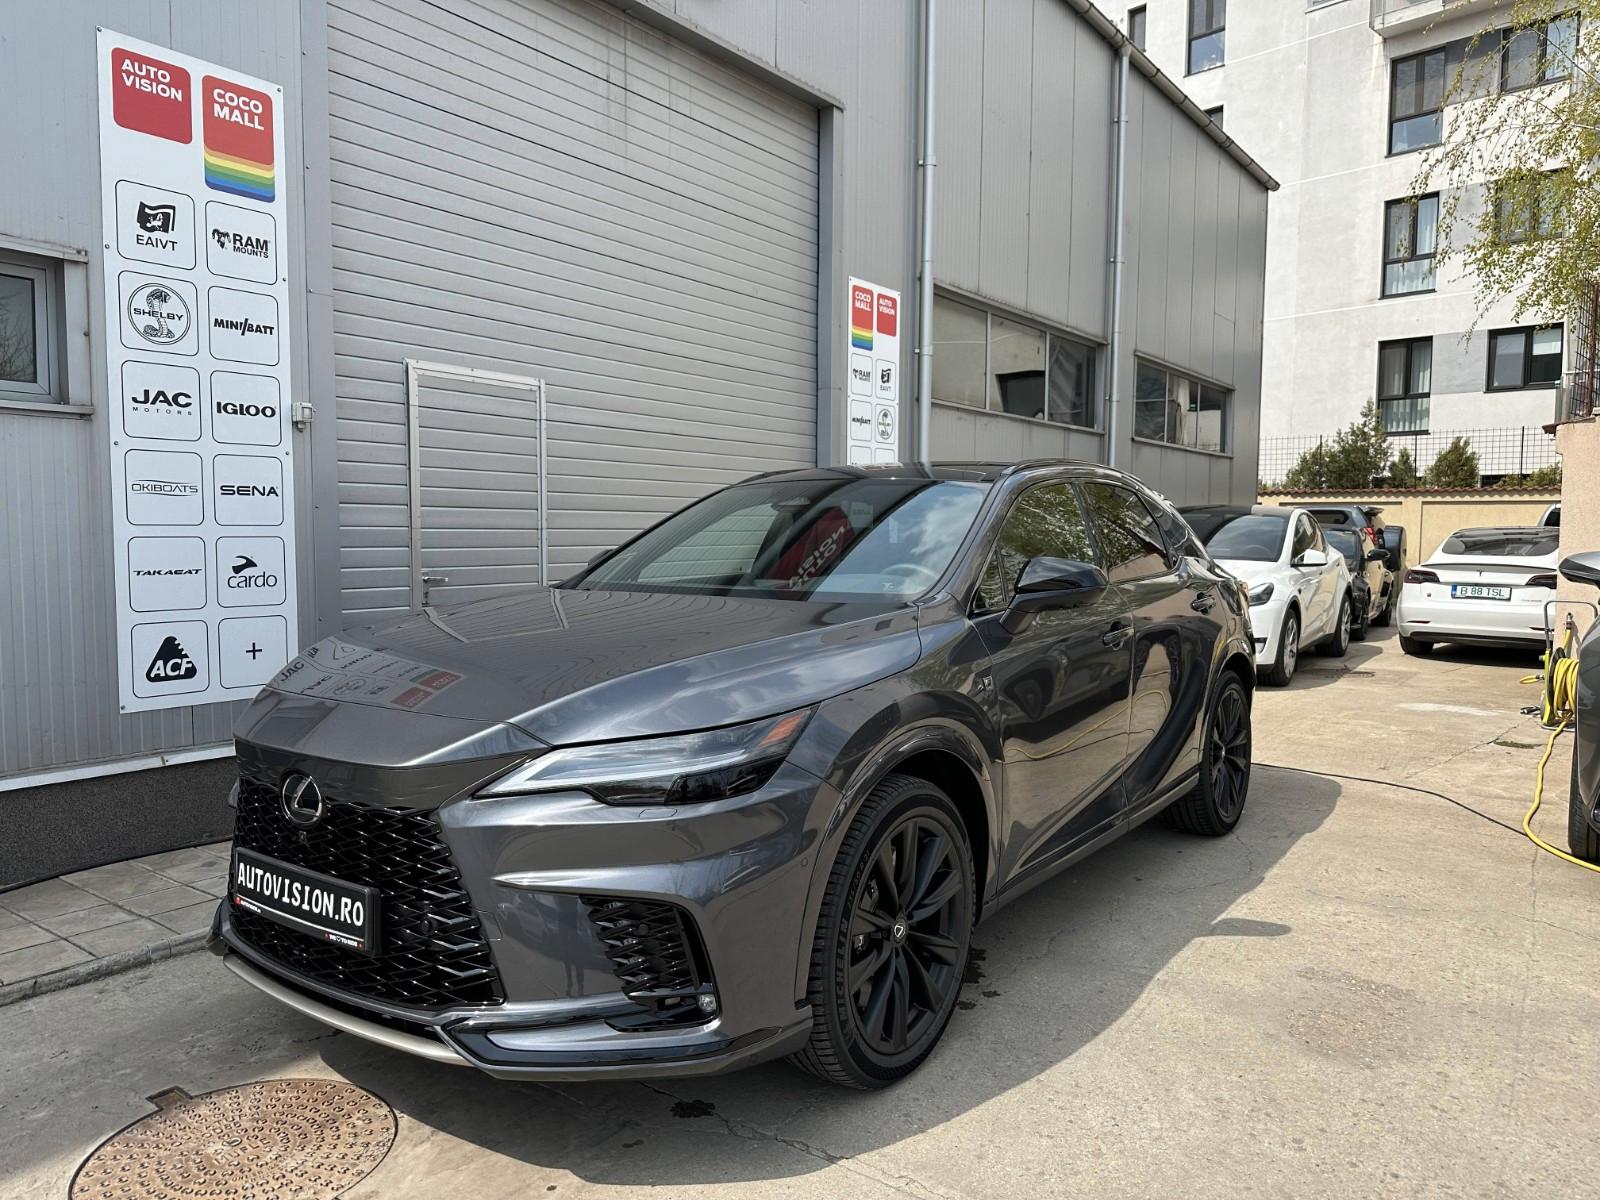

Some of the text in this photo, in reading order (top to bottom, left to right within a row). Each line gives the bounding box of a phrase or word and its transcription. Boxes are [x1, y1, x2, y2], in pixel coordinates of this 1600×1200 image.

[121, 59, 171, 83] AUTO
[122, 72, 182, 102] VISION
[213, 88, 263, 114] COCO
[213, 105, 264, 131] MALL
[136, 233, 178, 251] EAIVT
[232, 233, 268, 252] RAM
[232, 245, 269, 259] MOUNTS
[855, 291, 871, 303] COCO
[855, 299, 871, 312] MALL
[879, 297, 892, 307] AUTO
[133, 307, 184, 321] SHELBY
[879, 305, 895, 316] VISION
[131, 389, 193, 408] JAC
[132, 406, 192, 416] MOTORS
[216, 401, 276, 418] IGLOO
[131, 483, 199, 493] OKIBOATS
[220, 484, 279, 497] SENA
[227, 571, 278, 589] cardo
[1460, 586, 1505, 597] B 88 TSL
[150, 658, 193, 678] ACF
[237, 862, 365, 927] AUTOVISION.RO
